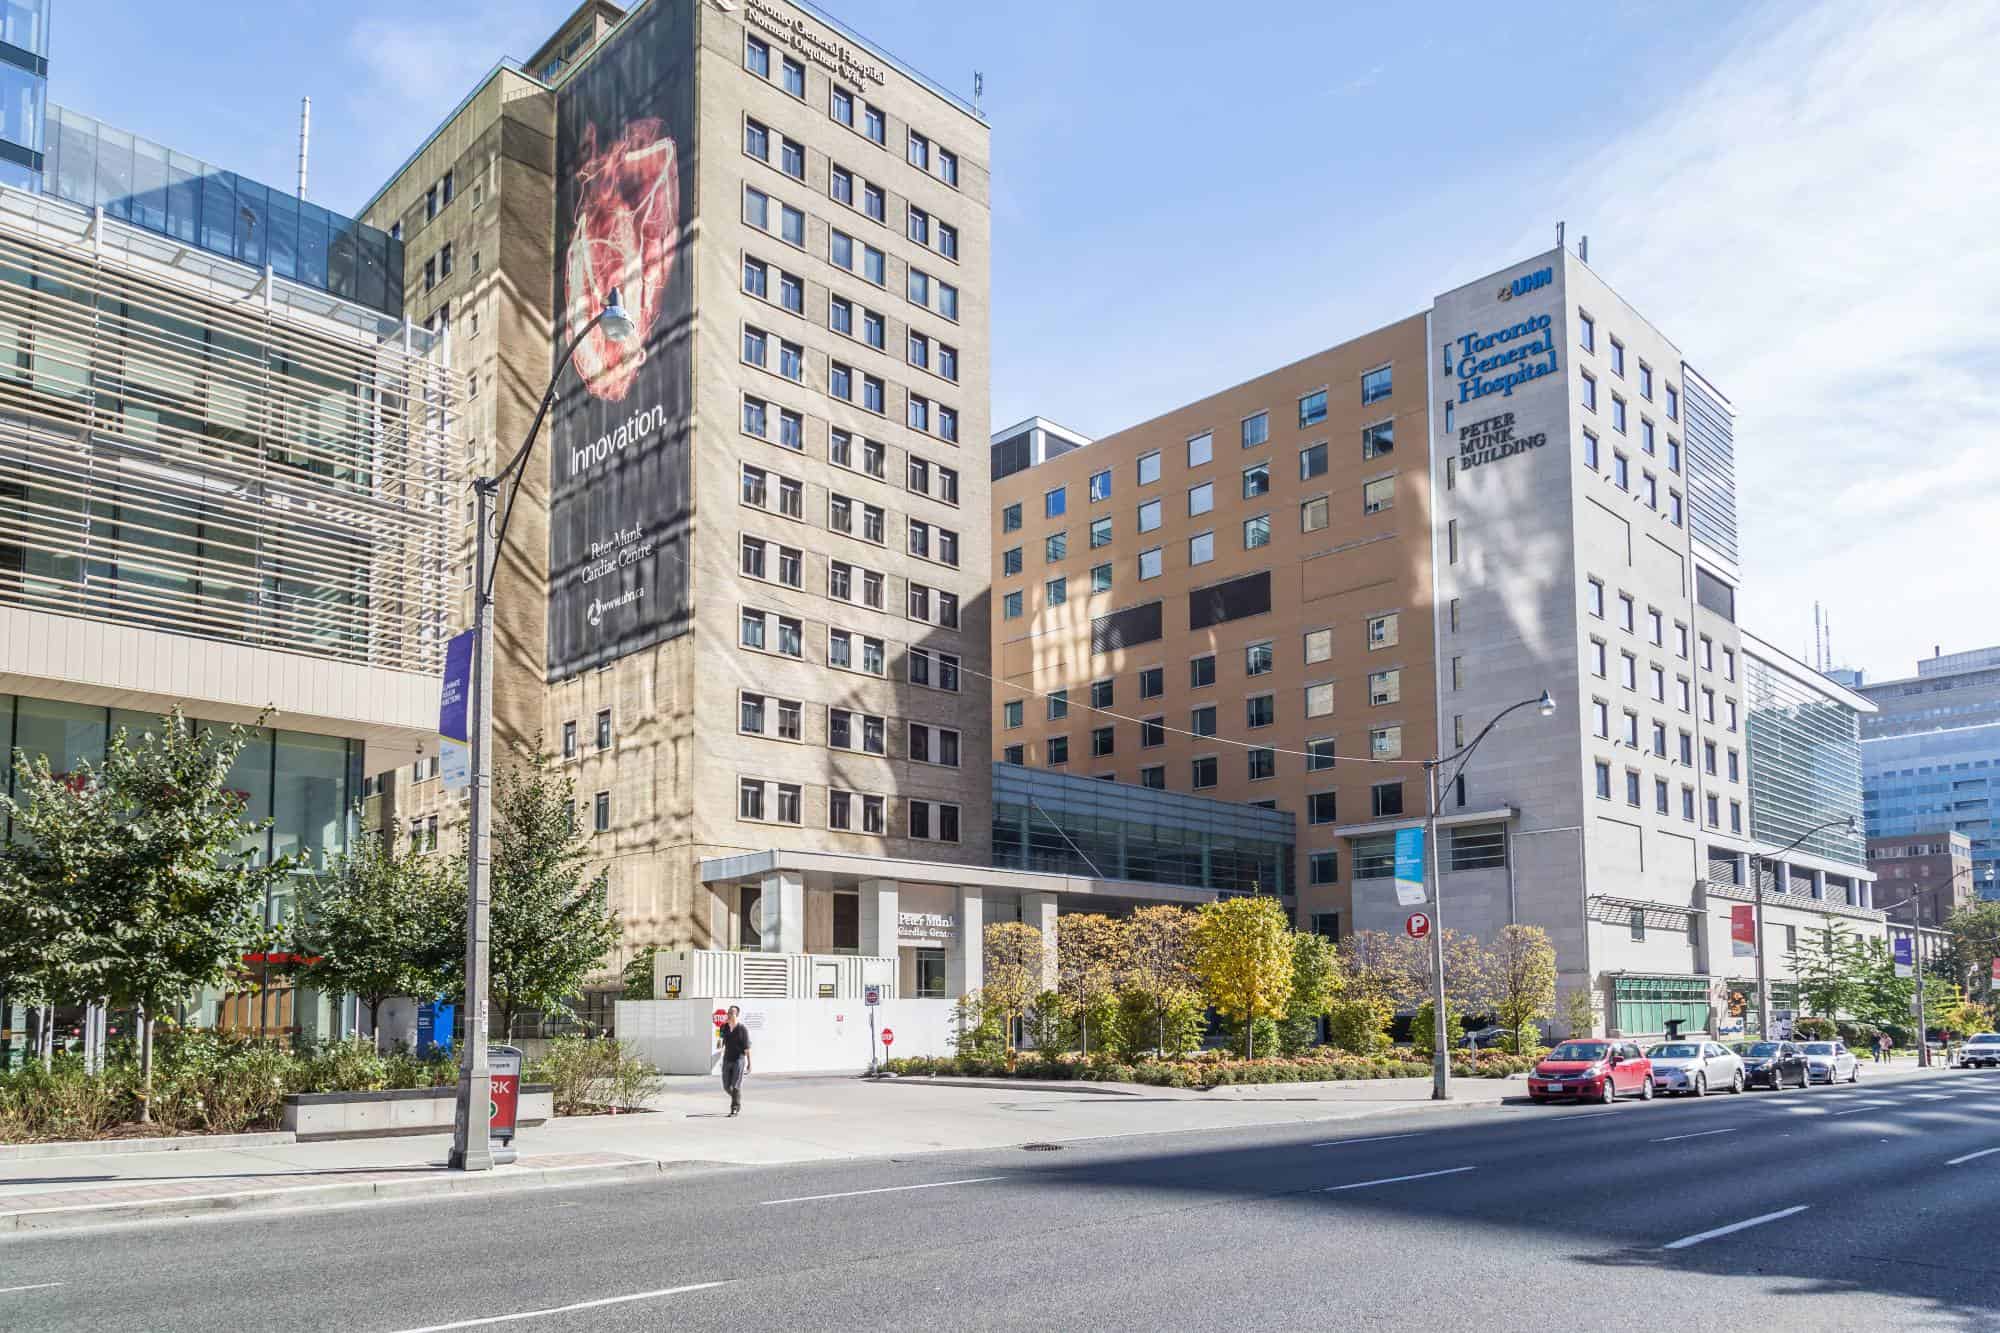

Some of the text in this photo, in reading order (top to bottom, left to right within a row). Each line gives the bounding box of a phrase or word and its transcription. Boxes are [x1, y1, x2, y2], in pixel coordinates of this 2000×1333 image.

[746, 7, 791, 43] Norman
[747, 0, 886, 85] oronto General Hospital
[1511, 267, 1553, 297] UHN
[1456, 313, 1551, 357] Toronto
[1456, 328, 1554, 380] General
[1457, 350, 1559, 404] Hospital
[571, 404, 667, 475] Innovation.
[1459, 412, 1516, 441] PETER
[1460, 426, 1517, 456] MUNK
[1461, 433, 1547, 471] BUILDING
[591, 521, 643, 560] Peter Munk
[582, 543, 652, 584] Cardiac Centre
[1411, 915, 1425, 933] P
[666, 976, 681, 992] CAT
